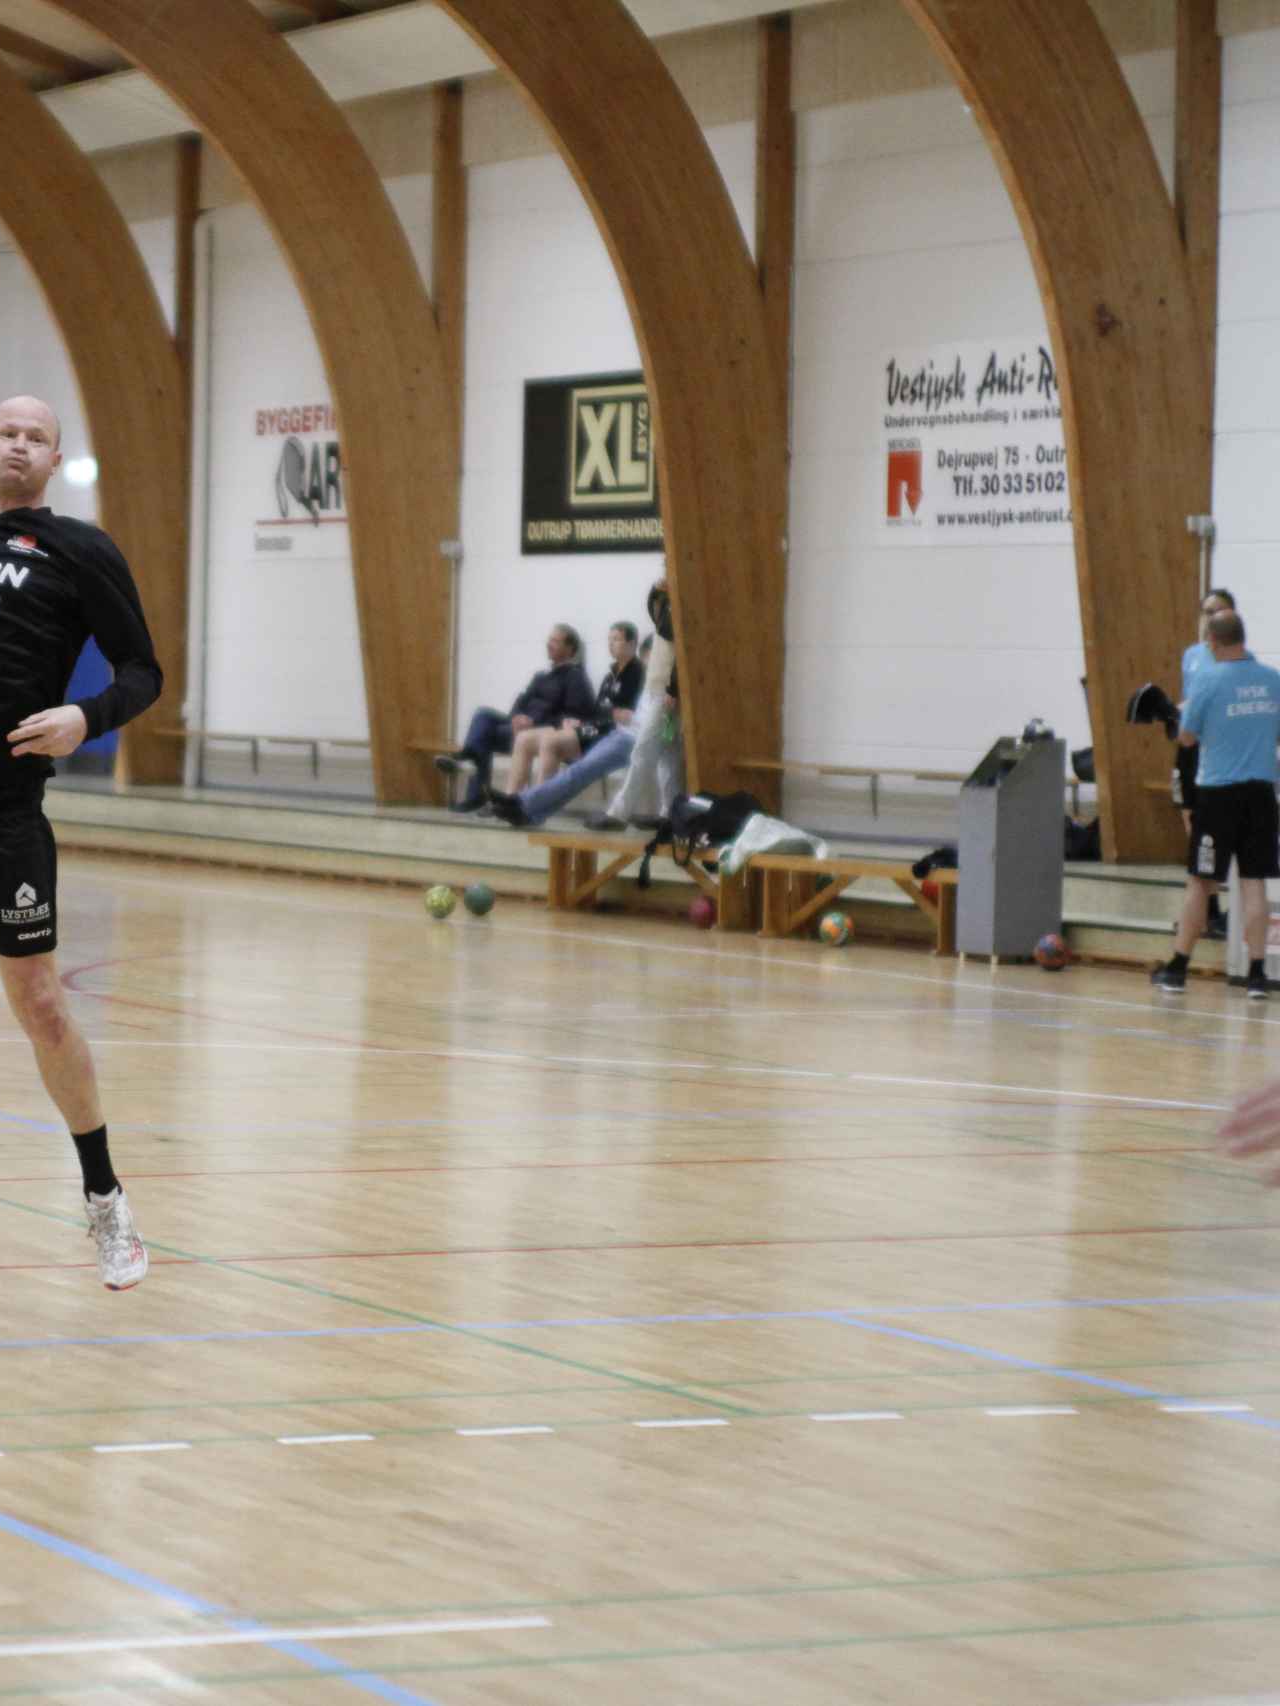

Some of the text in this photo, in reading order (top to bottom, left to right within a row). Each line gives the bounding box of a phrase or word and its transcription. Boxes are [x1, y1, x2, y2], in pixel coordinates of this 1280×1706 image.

[886, 356, 966, 412] Vestjysk
[576, 401, 647, 487] XL
[937, 448, 999, 472] Dejrupvej
[1004, 446, 1019, 465] 75
[527, 520, 572, 541] OUTRUP
